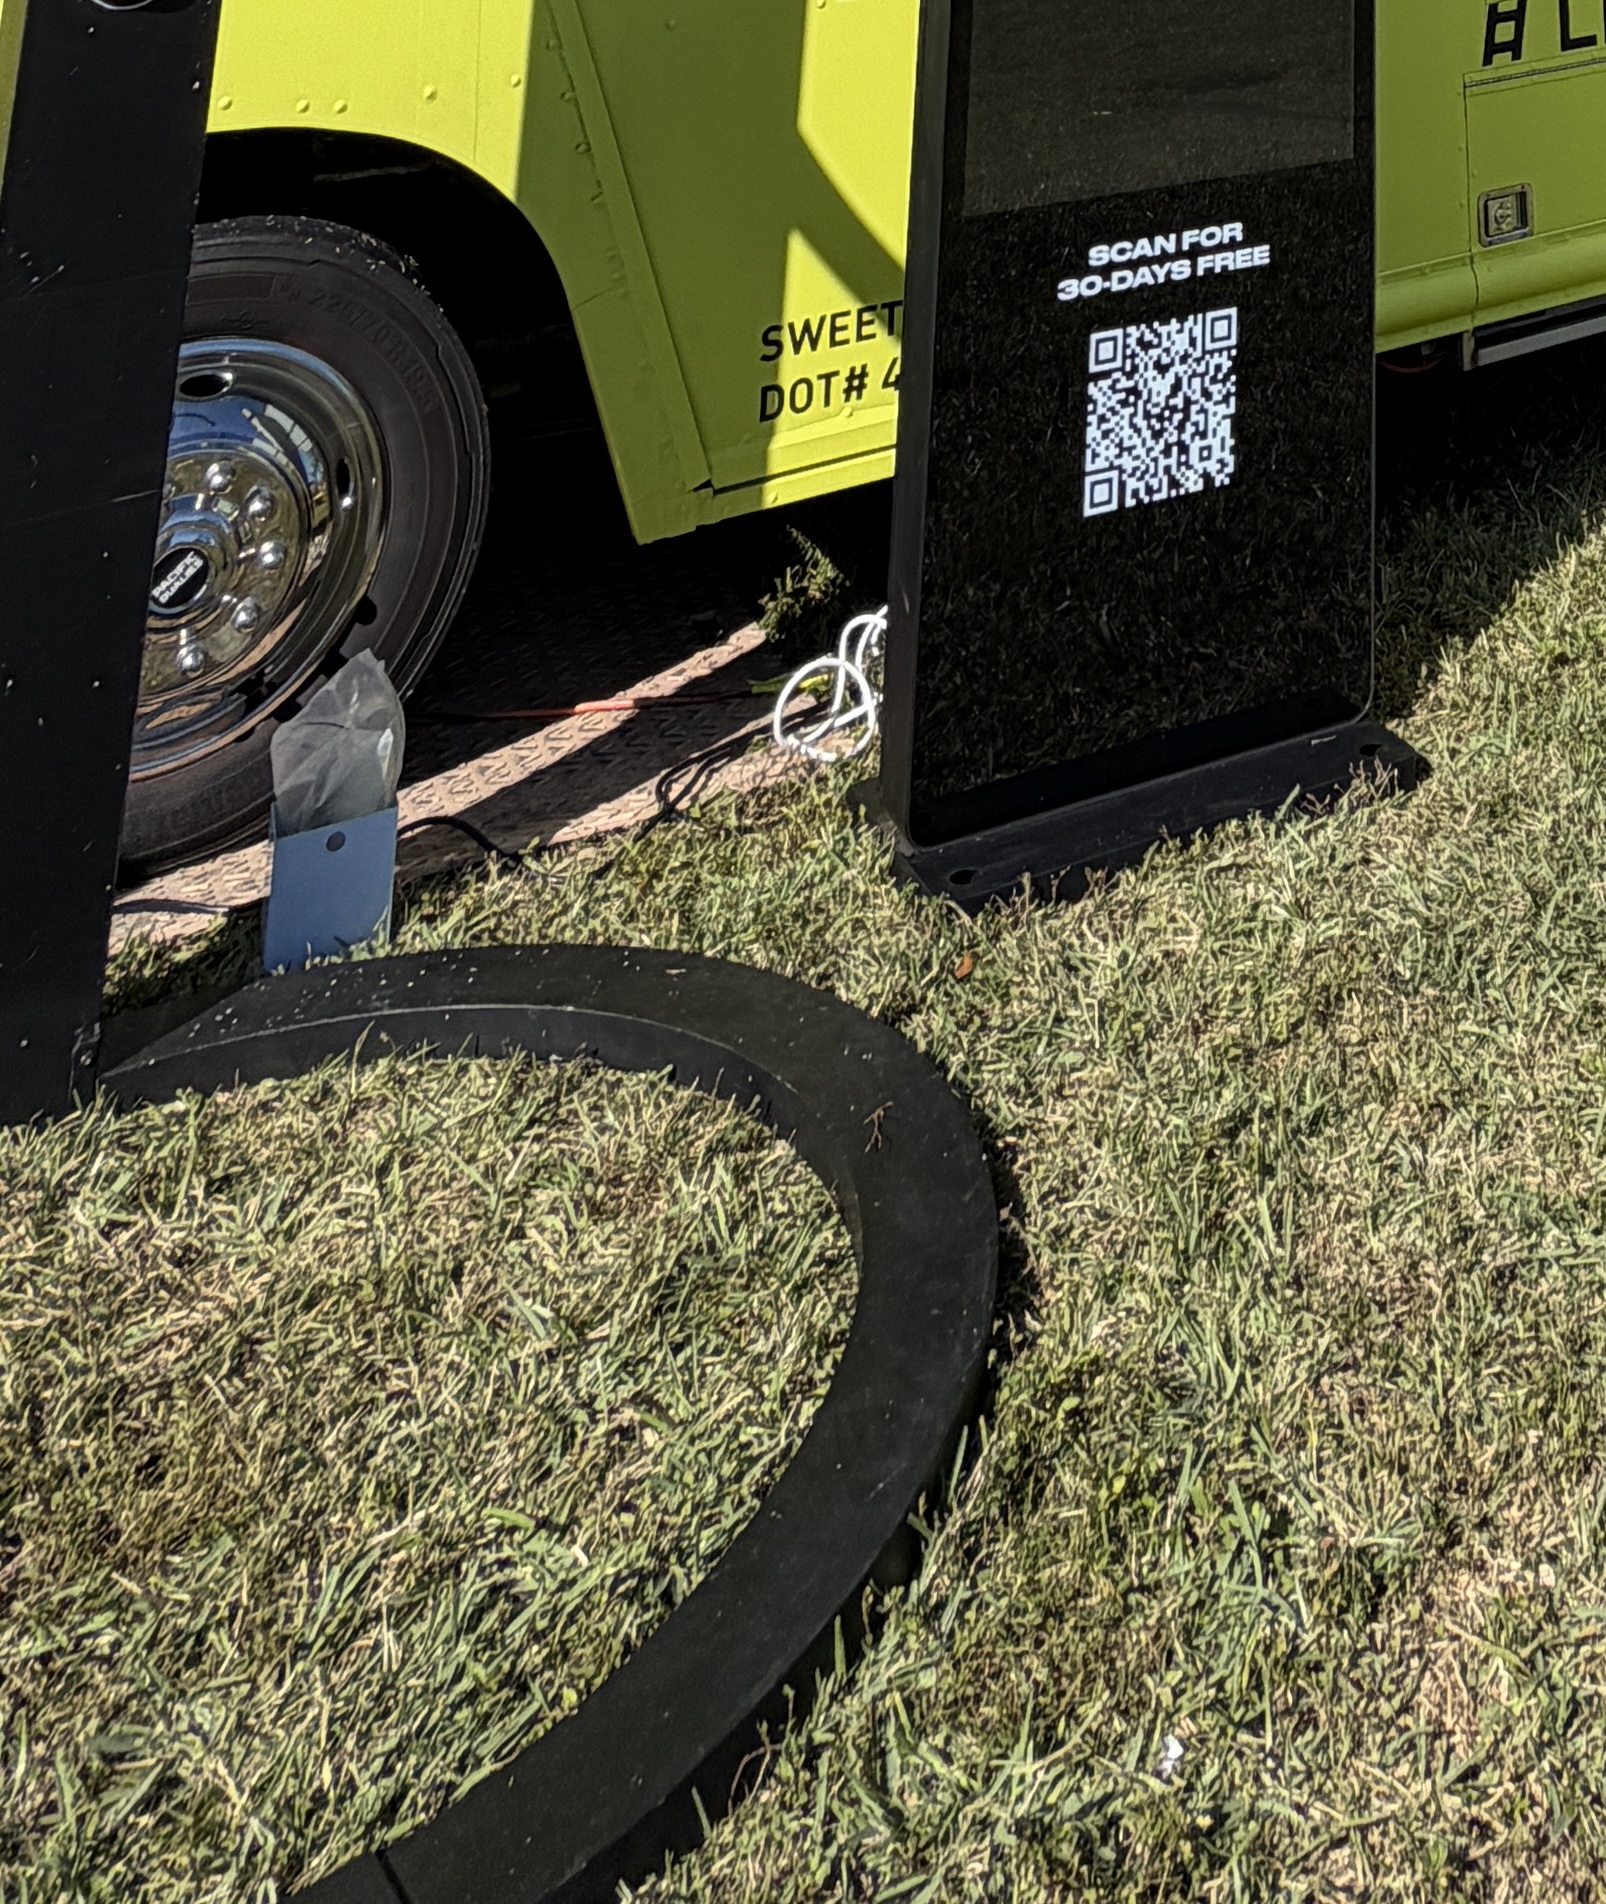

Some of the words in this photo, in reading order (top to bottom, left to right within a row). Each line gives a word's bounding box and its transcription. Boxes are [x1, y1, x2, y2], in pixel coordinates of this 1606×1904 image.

[1057, 259, 1191, 301] 30-DAYS
[1197, 245, 1270, 276] FREE
[1088, 233, 1177, 266] SCAN
[1182, 222, 1243, 251] FOR
[760, 300, 904, 362] SWEET
[760, 363, 869, 423] DOT#
